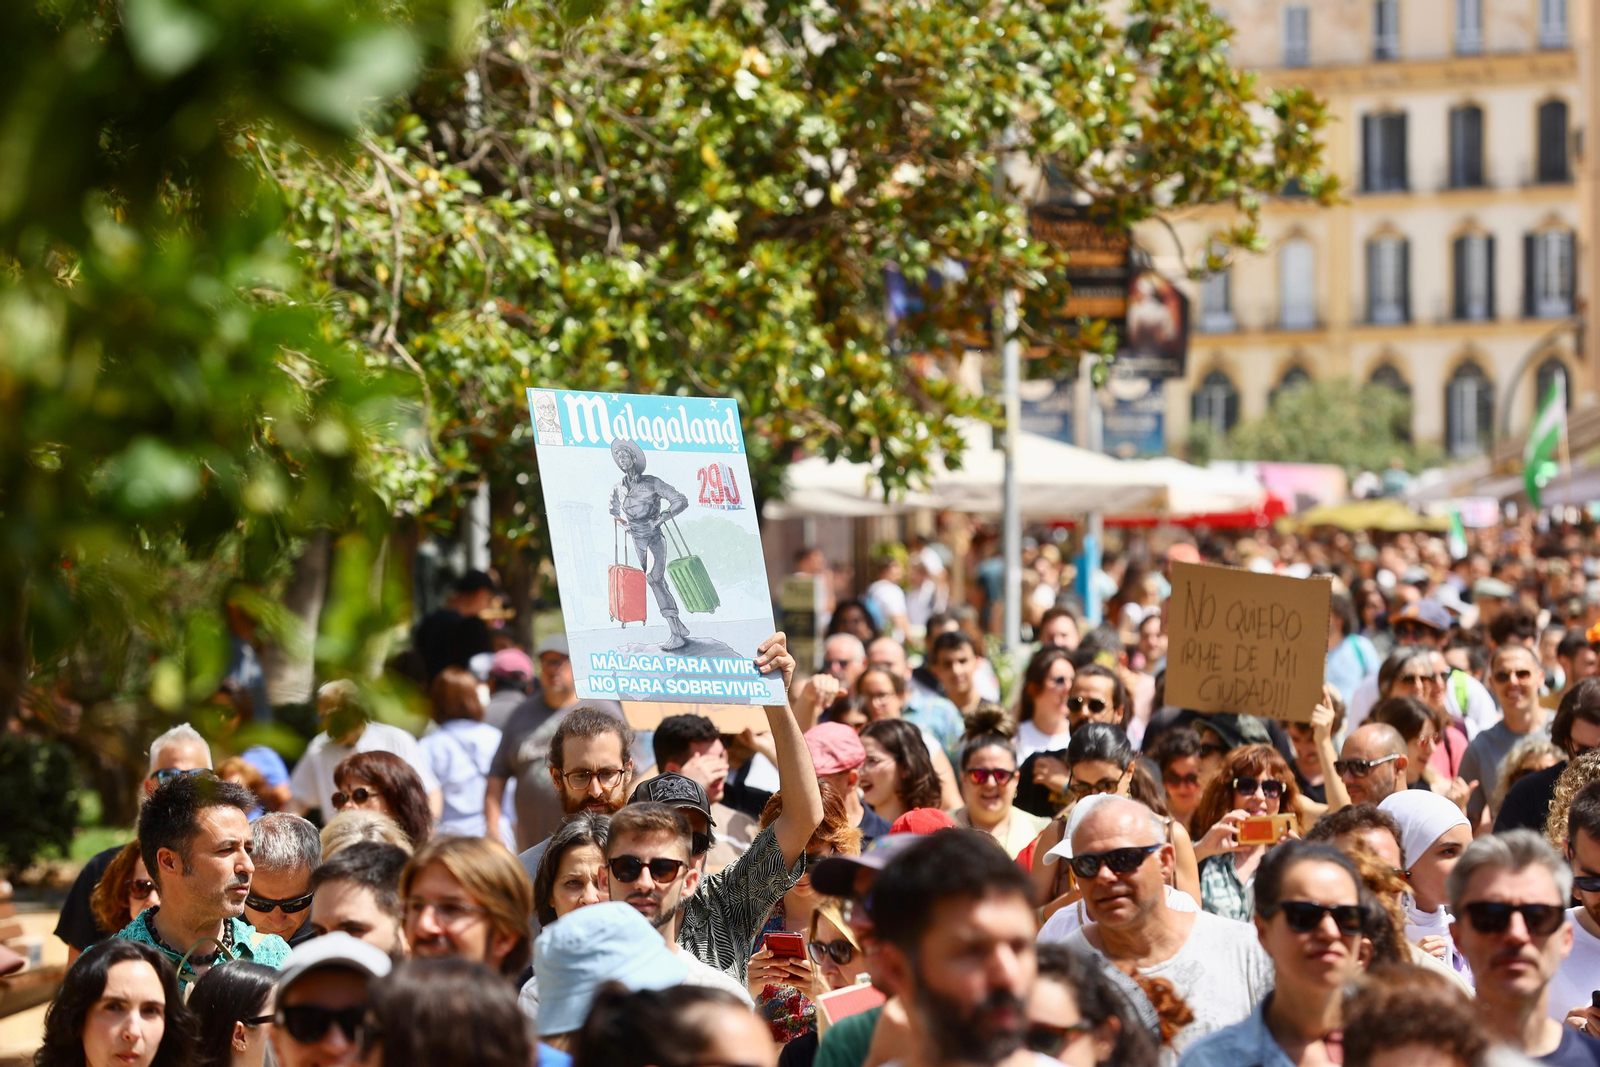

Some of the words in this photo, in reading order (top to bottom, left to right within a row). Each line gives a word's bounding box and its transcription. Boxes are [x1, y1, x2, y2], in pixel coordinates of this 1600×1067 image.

[562, 392, 740, 451] Málagaland
[1184, 580, 1216, 633] NO
[591, 651, 663, 673] MÁLAGA
[666, 657, 711, 673] PARA
[1234, 644, 1259, 672] DE
[1273, 647, 1298, 679] MI
[589, 677, 616, 692] NO
[618, 679, 665, 694] PARA
[666, 680, 771, 697] SOBREVIVIR.
